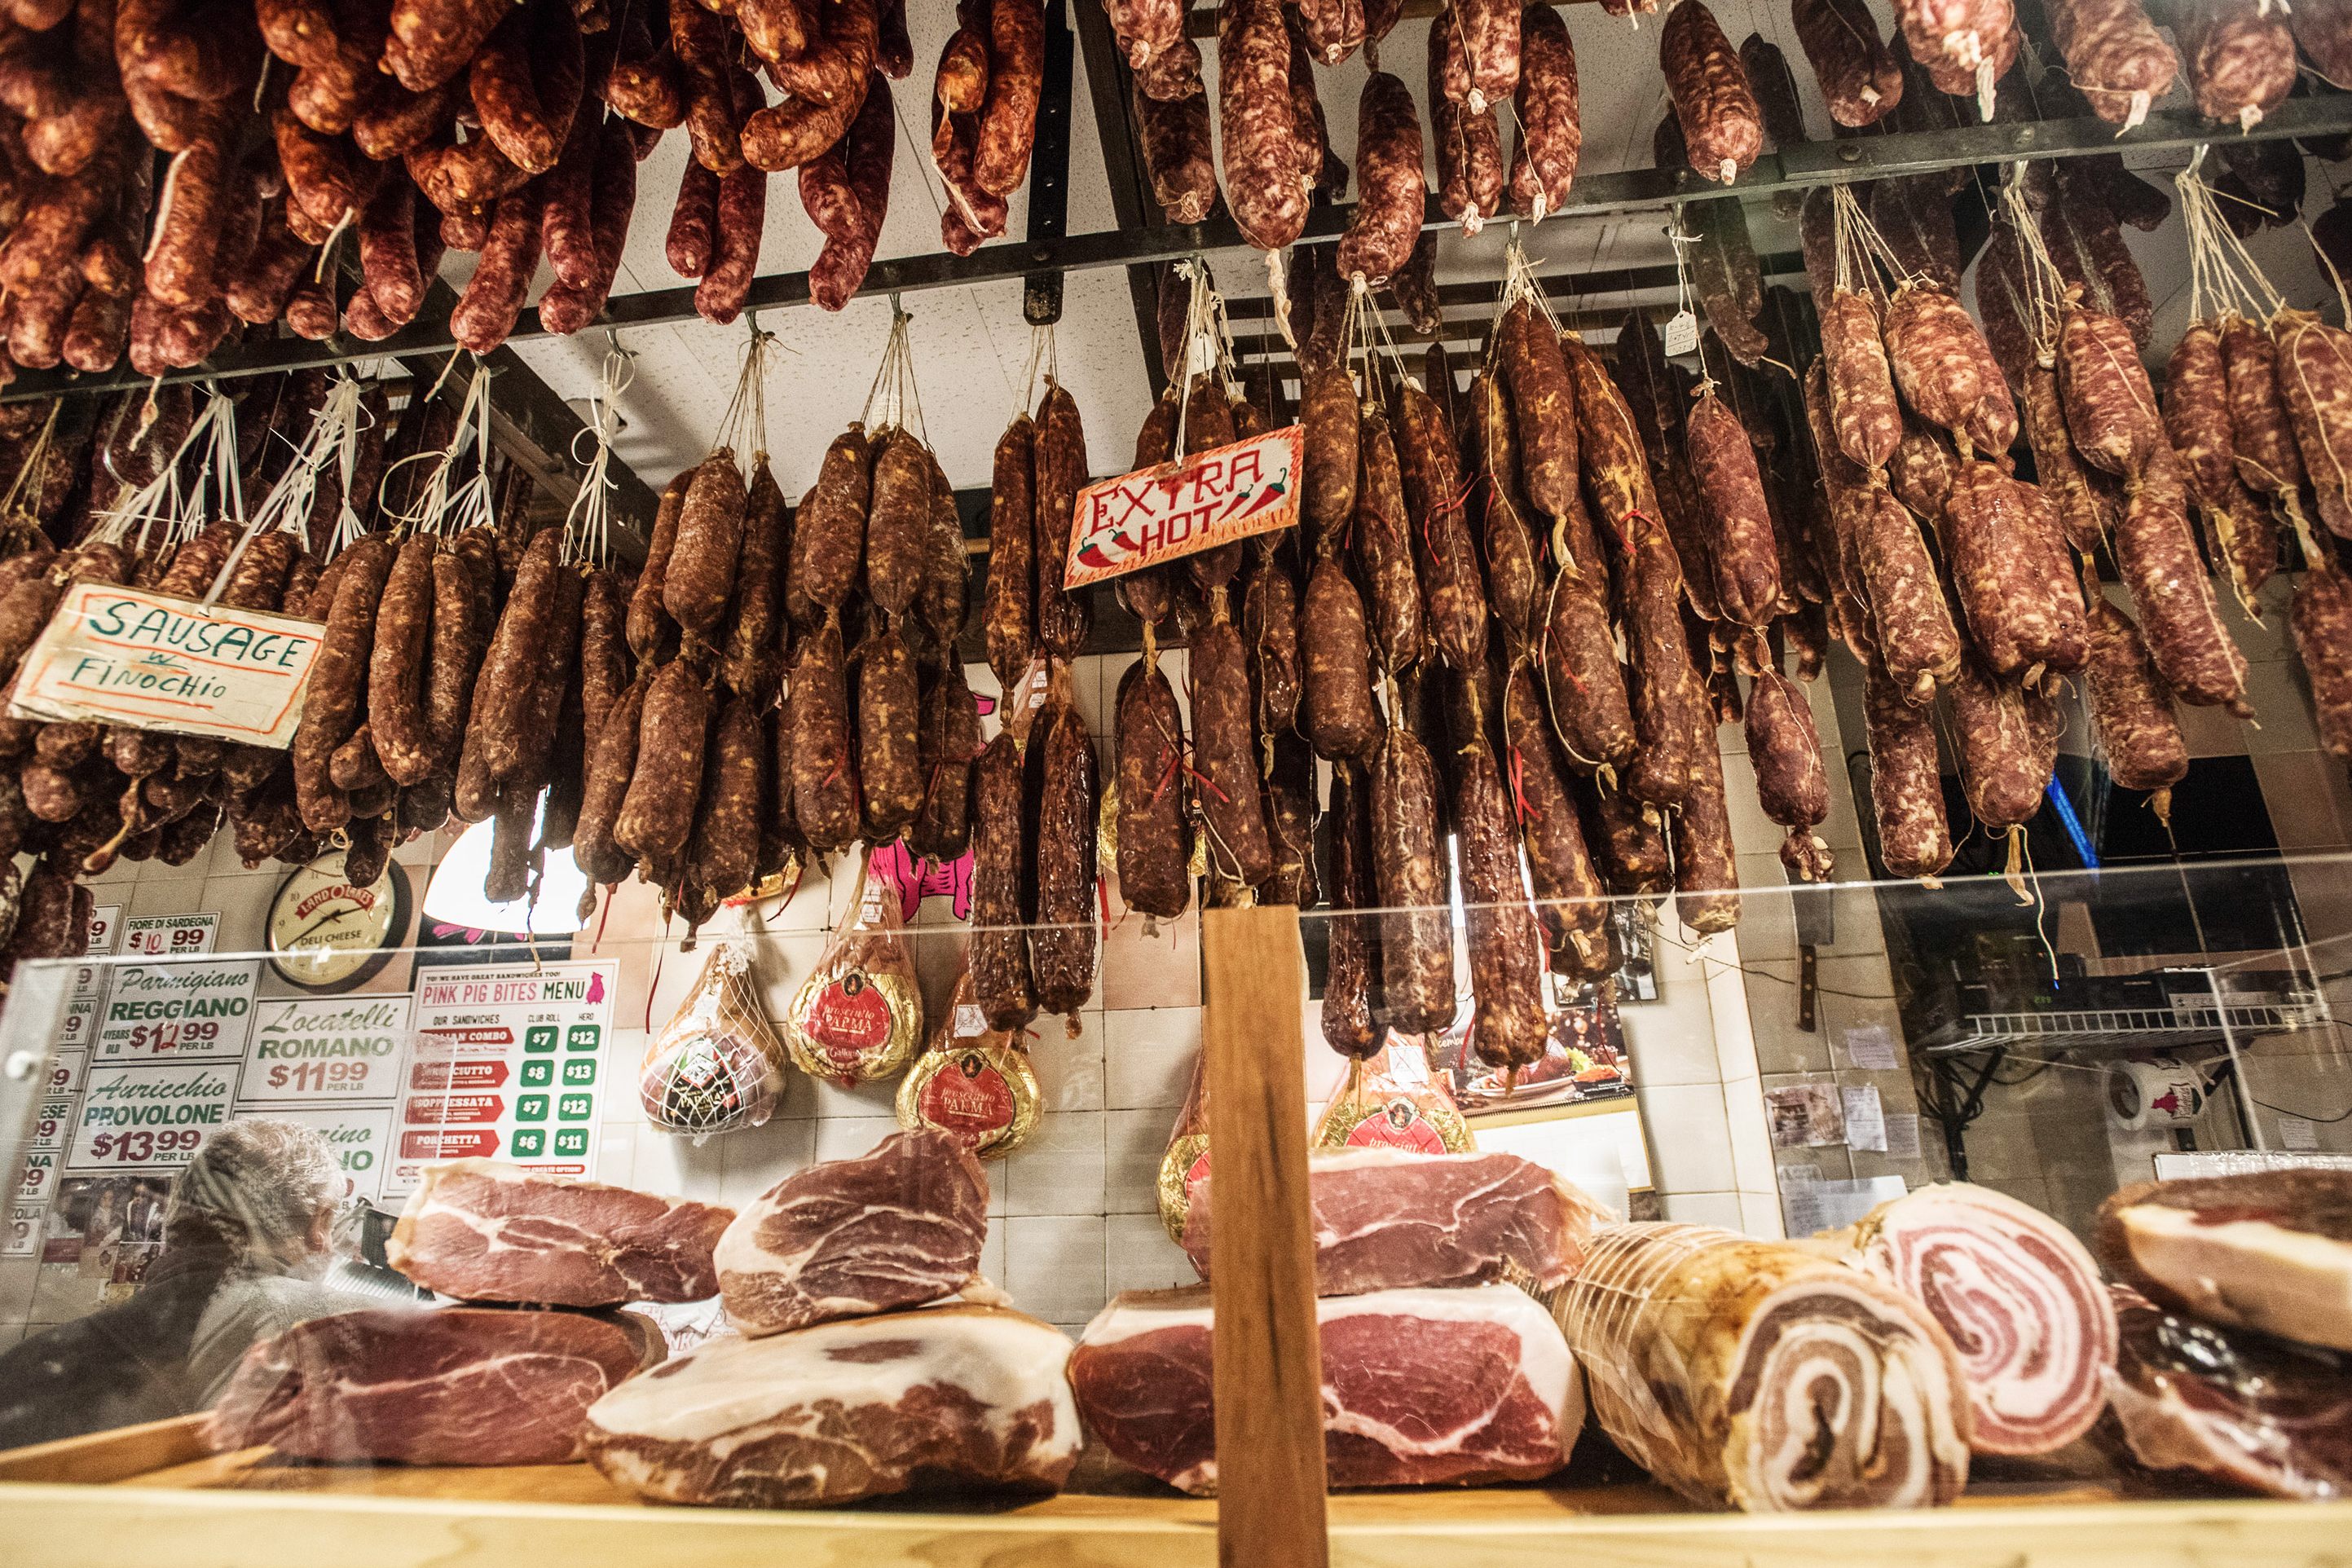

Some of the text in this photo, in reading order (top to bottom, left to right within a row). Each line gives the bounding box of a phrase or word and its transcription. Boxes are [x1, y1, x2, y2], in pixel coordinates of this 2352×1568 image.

[1089, 450, 1264, 537] EXTRA
[1141, 500, 1222, 557] HOT
[90, 601, 306, 667] SAUSAGE
[301, 889, 329, 913] LAND
[331, 885, 345, 899] O
[128, 917, 214, 931] FIORE DI SARDEGNA
[301, 930, 363, 946] DELI CHEESE
[119, 968, 249, 997] Parmigiano
[423, 981, 585, 1004] PINK PIG BITES MENU
[109, 997, 249, 1021] REGGIANO
[579, 1012, 594, 1020] HERO
[262, 1003, 399, 1033] Locatelli
[433, 1014, 500, 1026] OUR SANDWICHES
[527, 1014, 561, 1023] CLUB ROLL
[469, 1031, 508, 1042] COMBO
[532, 1033, 551, 1046] $7
[570, 1031, 595, 1045] $12
[258, 1037, 394, 1059] ROMANO
[527, 1066, 546, 1080] $8
[566, 1064, 592, 1079] $13
[87, 1071, 227, 1101] Auricchio
[327, 1083, 348, 1091] PER
[523, 1100, 542, 1115] $7
[562, 1099, 588, 1114] $12
[83, 1103, 225, 1126] PROVOLONE
[518, 1135, 537, 1150] $6
[557, 1134, 583, 1149] $11
[153, 1152, 195, 1161] PER LB
